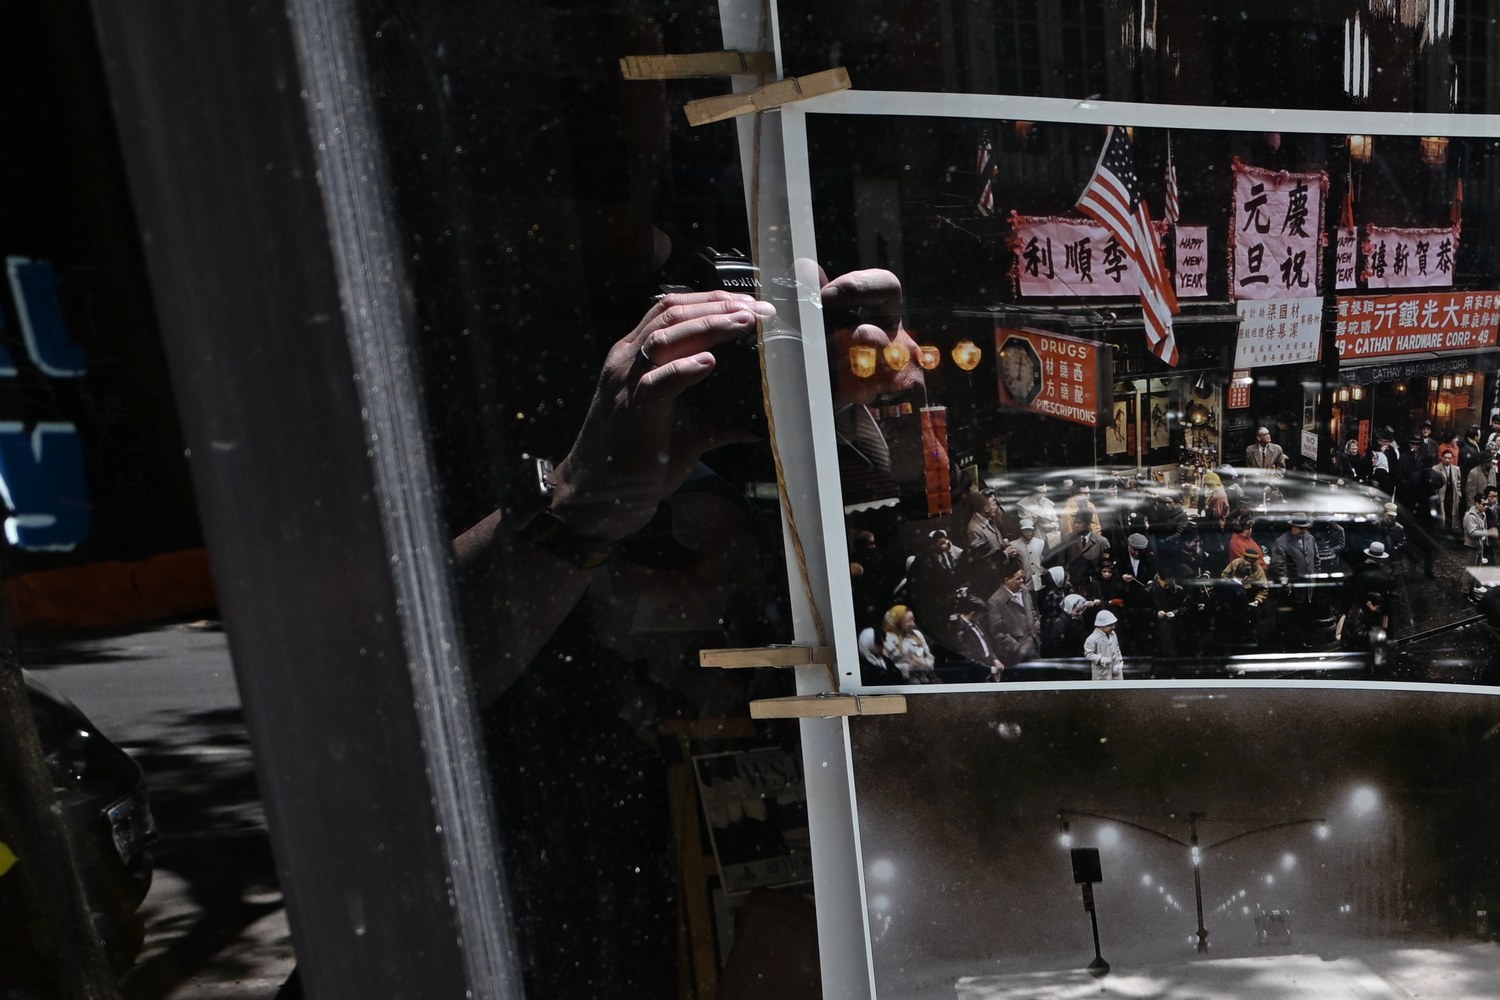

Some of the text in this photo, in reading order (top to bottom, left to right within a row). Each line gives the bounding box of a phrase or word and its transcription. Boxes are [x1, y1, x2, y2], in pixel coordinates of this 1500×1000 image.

[1180, 238, 1204, 250] HAPPY
[1183, 255, 1202, 266] NEW
[1180, 272, 1203, 288] YEAR
[1041, 338, 1087, 359] DRUGS
[1355, 336, 1395, 354] CATHAY
[1396, 333, 1442, 351] HARDWARE
[1446, 331, 1470, 347] CORP.
[1478, 330, 1489, 343] 49
[1372, 366, 1402, 380] CATHAY
[1036, 399, 1096, 424] PRESCRIPTIONS
[1306, 436, 1314, 444] NO
